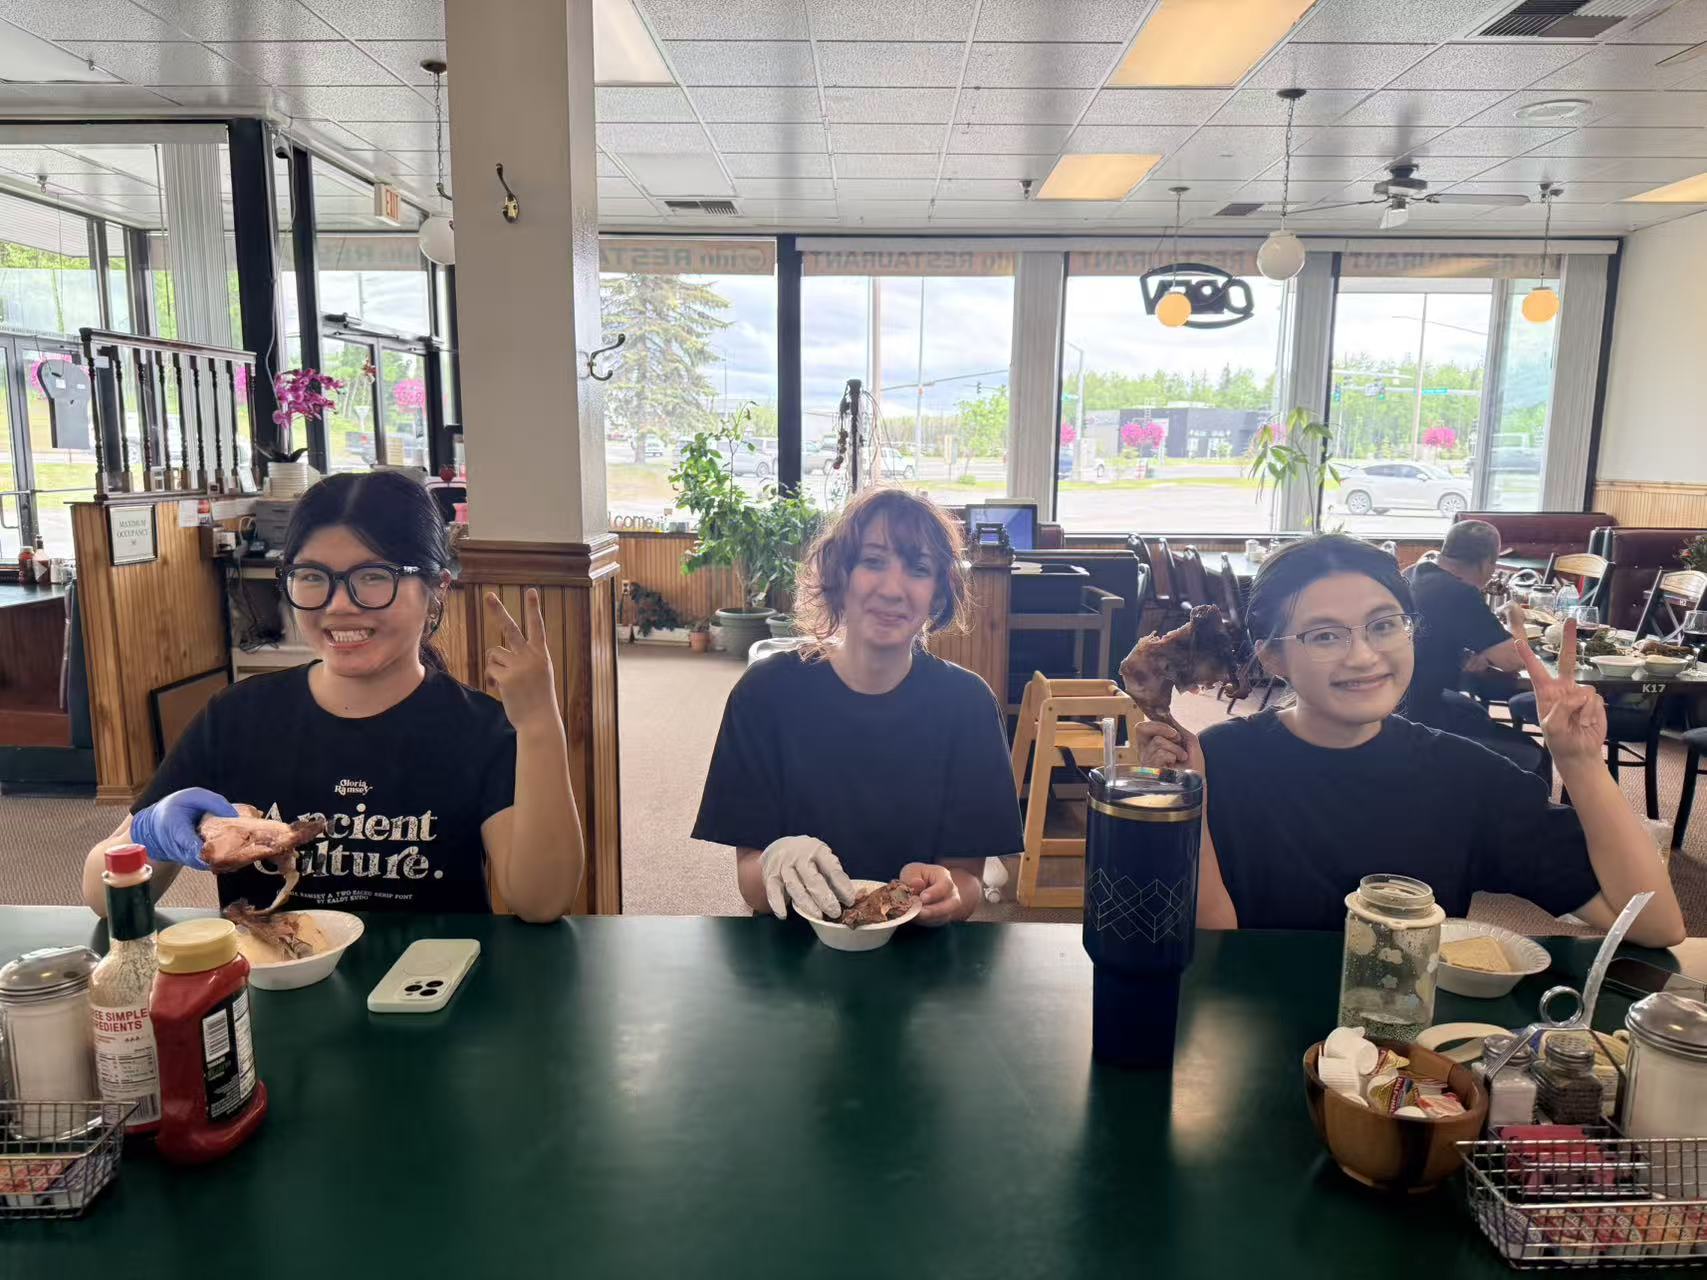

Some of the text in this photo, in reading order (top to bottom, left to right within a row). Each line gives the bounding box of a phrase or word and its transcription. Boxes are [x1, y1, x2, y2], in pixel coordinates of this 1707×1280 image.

[1642, 683, 1666, 693] K17
[340, 779, 367, 788] Gloria
[334, 785, 373, 796] Ramsey
[105, 1008, 148, 1021] SIMPLE
